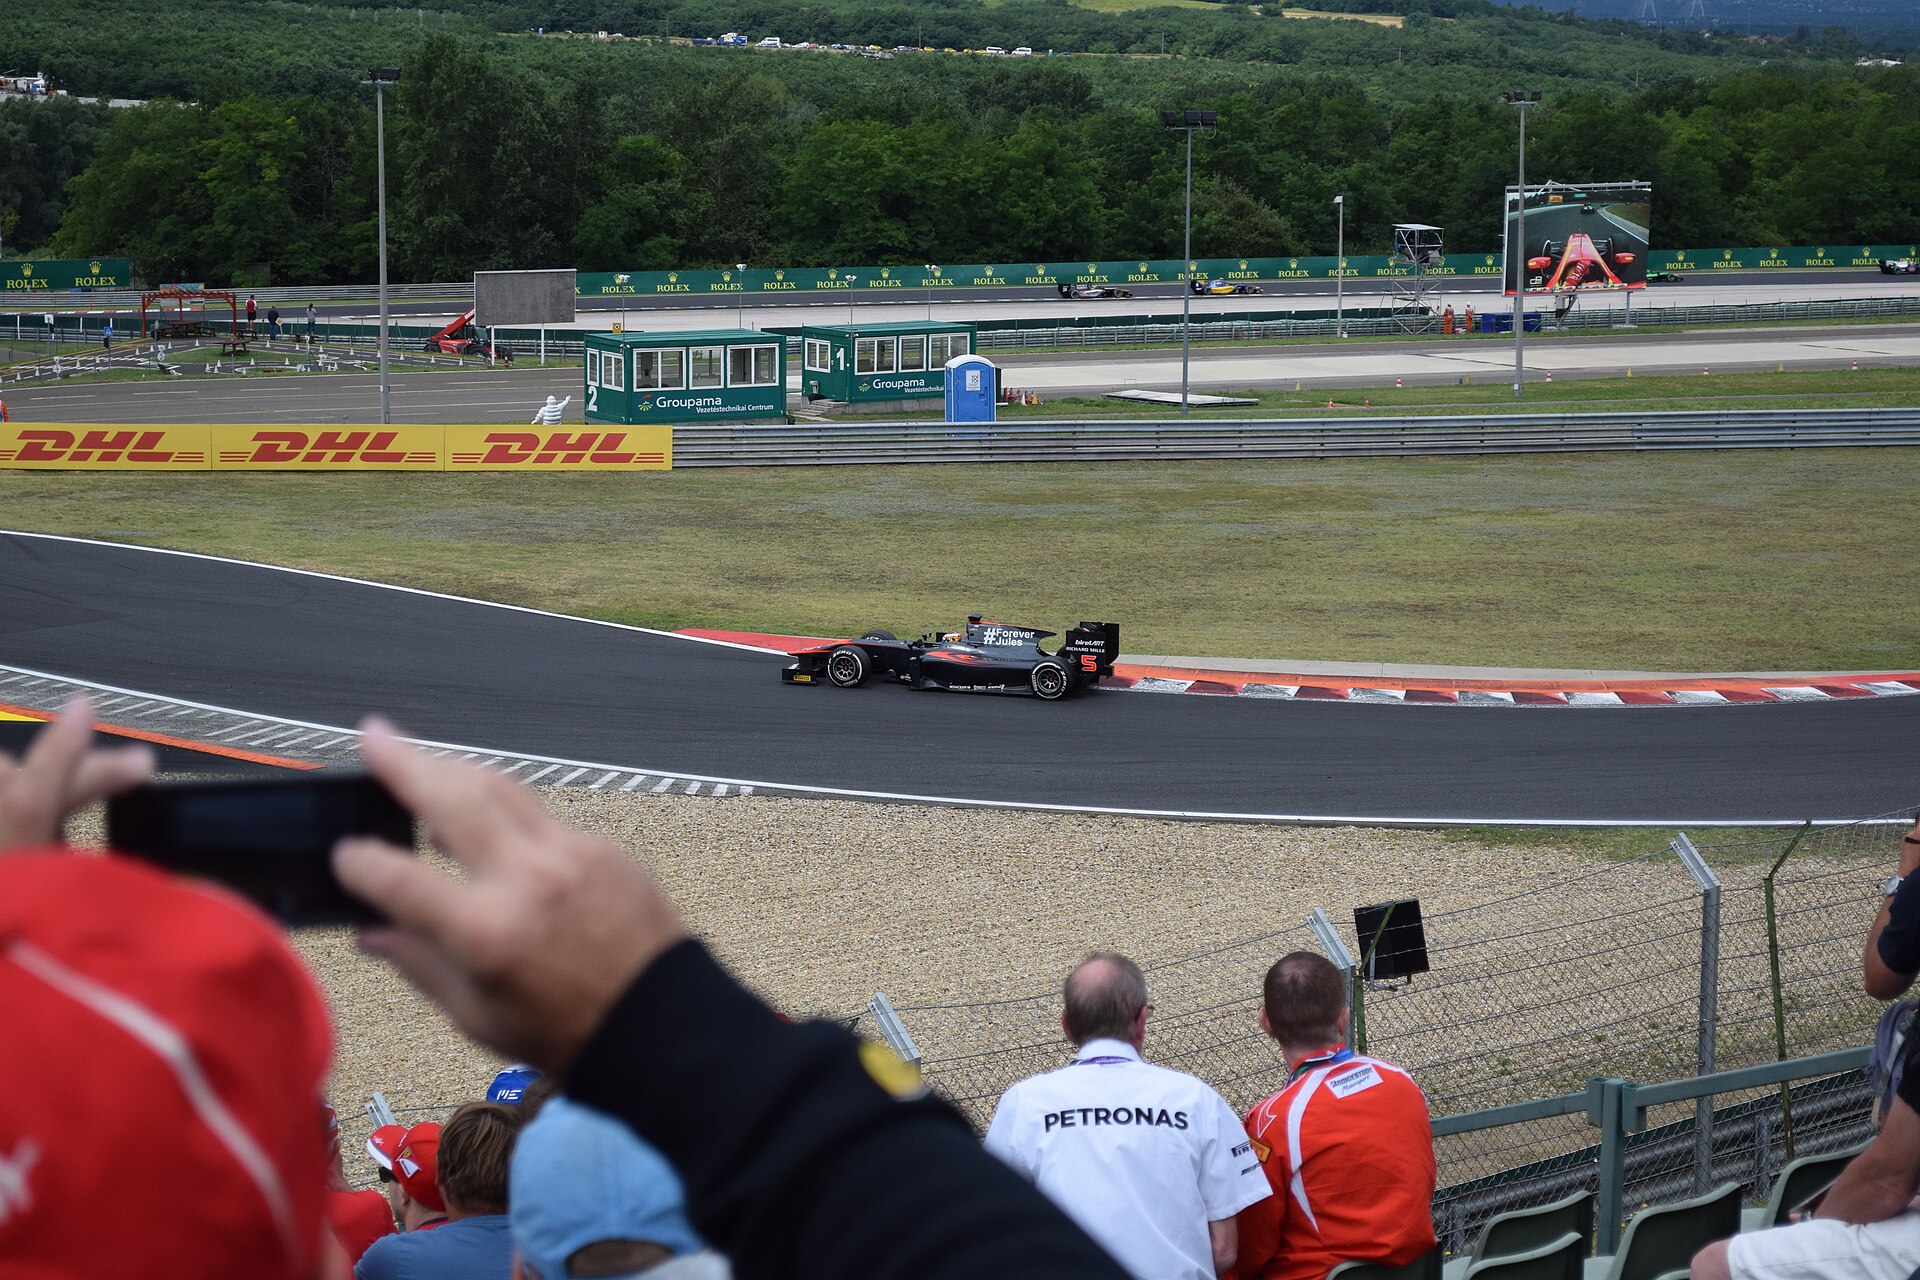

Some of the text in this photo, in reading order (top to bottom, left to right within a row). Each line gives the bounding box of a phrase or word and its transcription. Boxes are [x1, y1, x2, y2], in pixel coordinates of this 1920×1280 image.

[6, 279, 48, 288] ROLEX
[75, 277, 116, 286] ROLEX
[1026, 276, 1057, 284] ROLEX
[1128, 274, 1160, 282] ROLEX
[836, 348, 844, 370] 1
[872, 379, 924, 390] Groupama
[588, 386, 598, 412] 2
[656, 396, 722, 409] Groupama
[15, 431, 175, 463] DHL
[249, 432, 408, 463] DHL
[482, 433, 635, 464] DHL
[996, 637, 1022, 646] Jules
[1081, 654, 1097, 672] 5
[1044, 1108, 1189, 1132] PETRONAS
